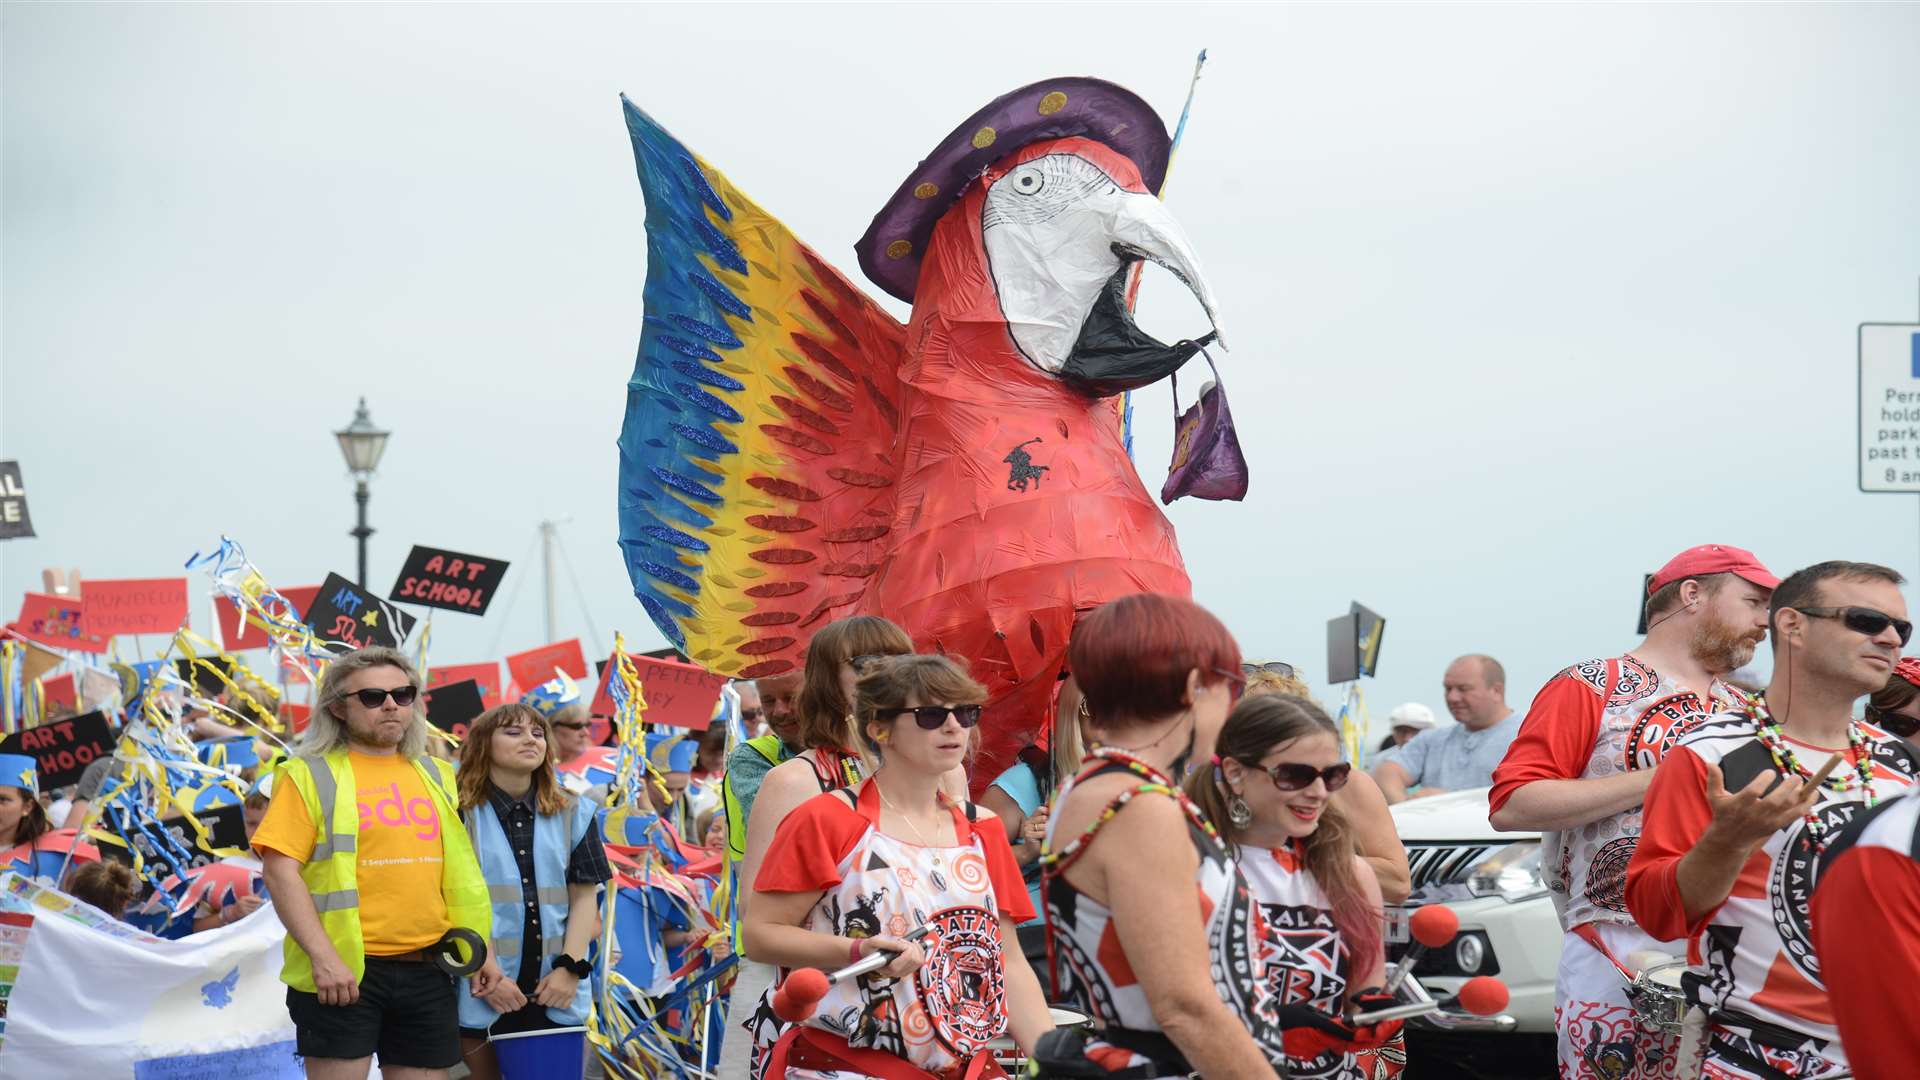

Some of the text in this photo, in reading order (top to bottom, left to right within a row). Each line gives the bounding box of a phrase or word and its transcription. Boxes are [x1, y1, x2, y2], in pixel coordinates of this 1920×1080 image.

[1886, 388, 1920, 403] Per
[1878, 427, 1918, 442] park
[1868, 446, 1907, 461] past
[1886, 467, 1896, 483] 8
[424, 555, 487, 582] ART
[331, 587, 364, 616] ART
[400, 576, 484, 609] SCHOOL
[21, 721, 75, 752] ART
